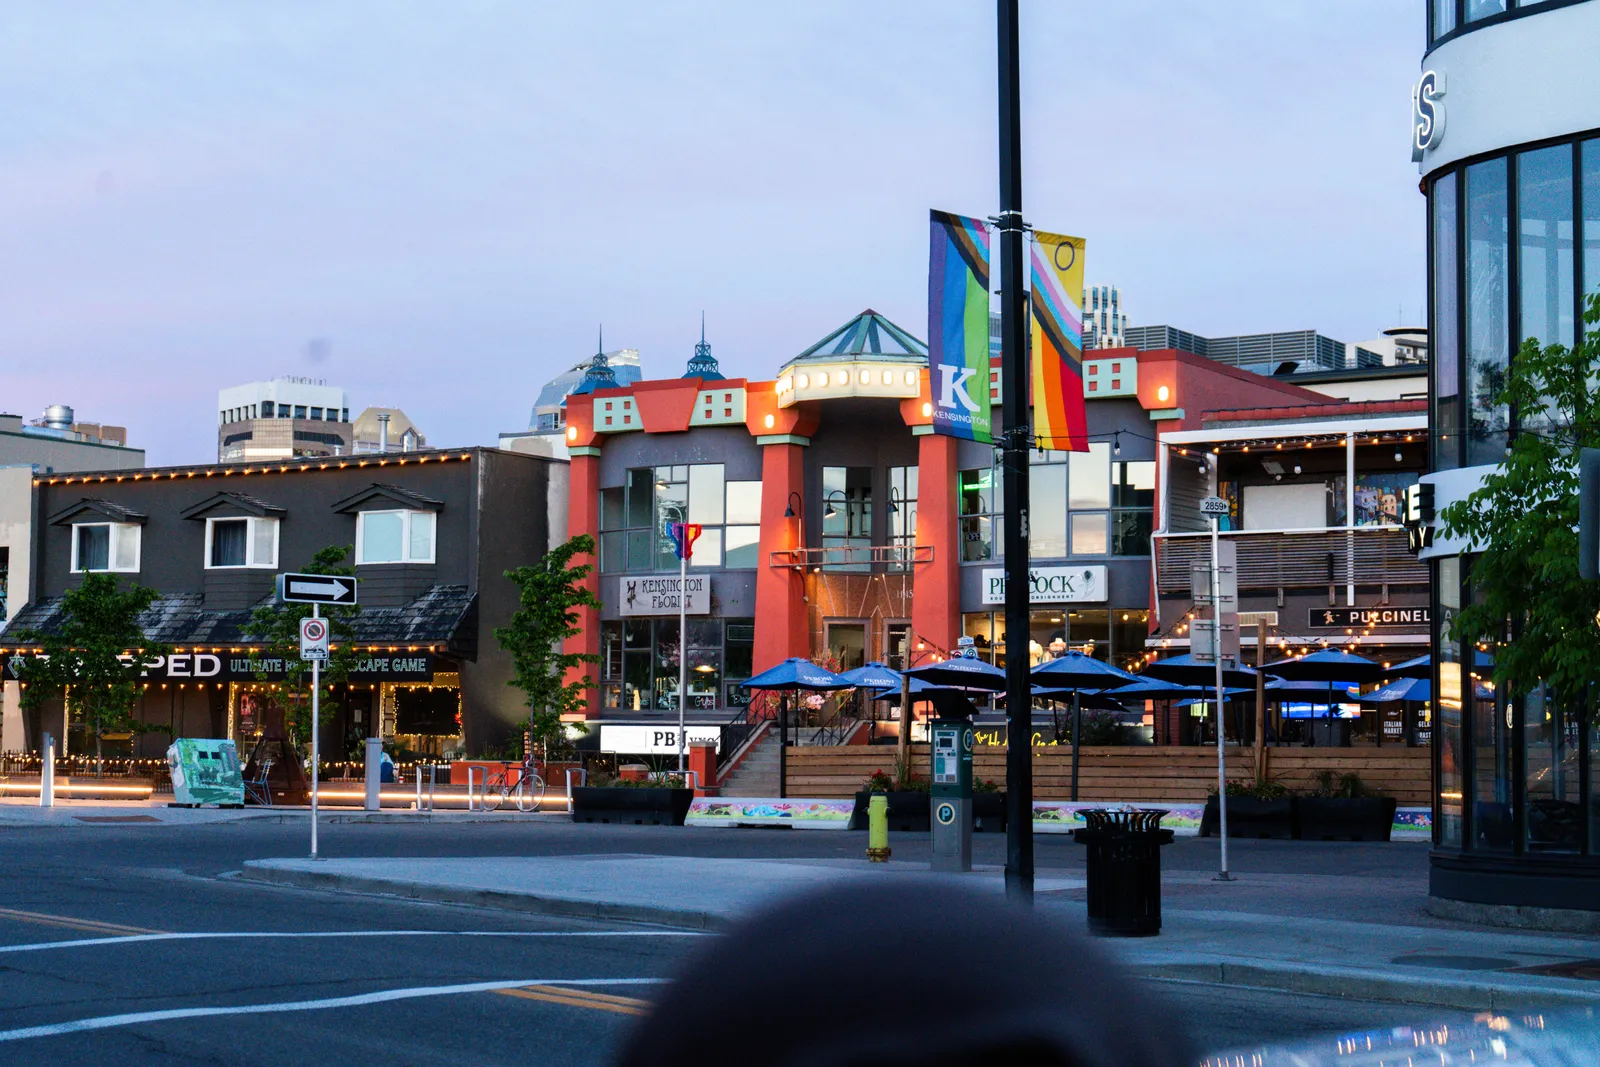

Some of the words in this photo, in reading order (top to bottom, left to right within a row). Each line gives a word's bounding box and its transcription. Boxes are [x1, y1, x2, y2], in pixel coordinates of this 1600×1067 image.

[937, 363, 981, 413] K
[933, 410, 988, 427] KENSINGTON
[1205, 501, 1224, 511] 2859
[642, 579, 703, 596] KENSINGTON
[652, 595, 693, 609] FLORIT
[391, 657, 426, 672] GAME
